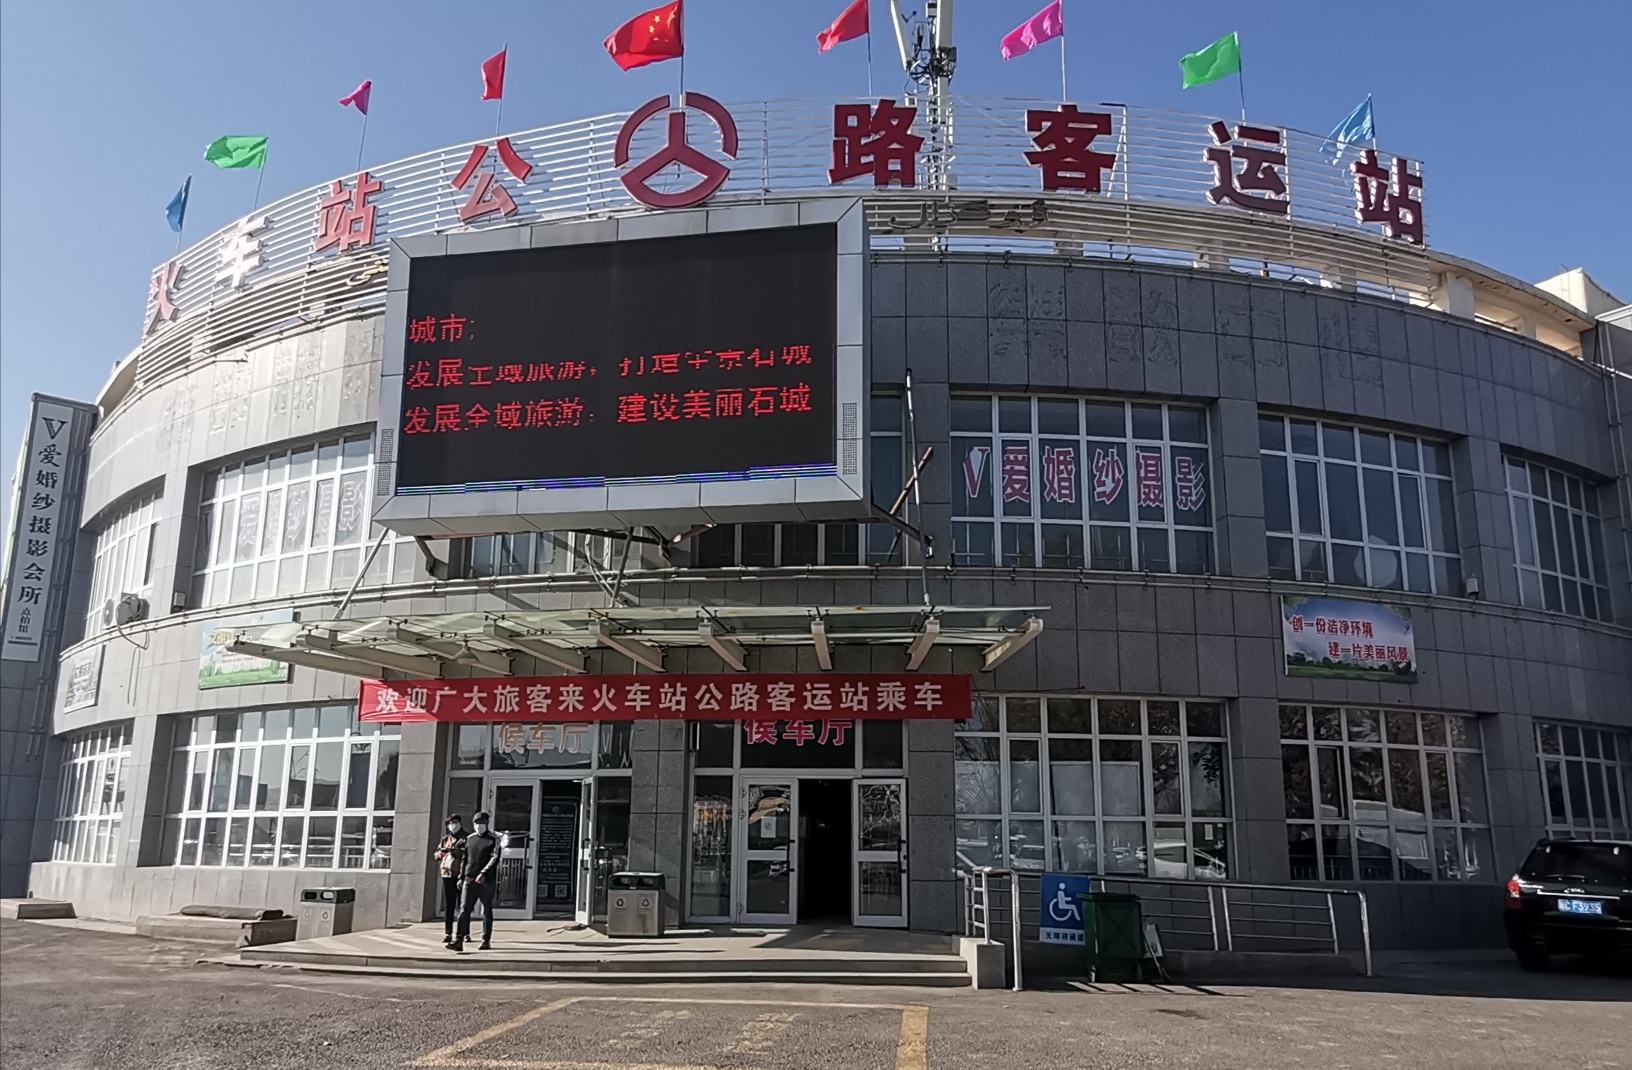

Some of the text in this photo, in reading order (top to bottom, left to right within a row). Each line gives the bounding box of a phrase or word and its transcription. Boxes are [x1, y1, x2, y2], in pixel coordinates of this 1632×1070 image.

[963, 445, 1207, 512] V爱婚纱摄影
[18, 417, 68, 605] V爱婚纱摄影会所
[1291, 614, 1375, 638] 创一份洁净环境
[1327, 641, 1409, 663] 建一片美丽风景
[375, 682, 944, 714] 欢迎广大旅客来火车站公路客运站乘车
[498, 722, 589, 755] 候车厅
